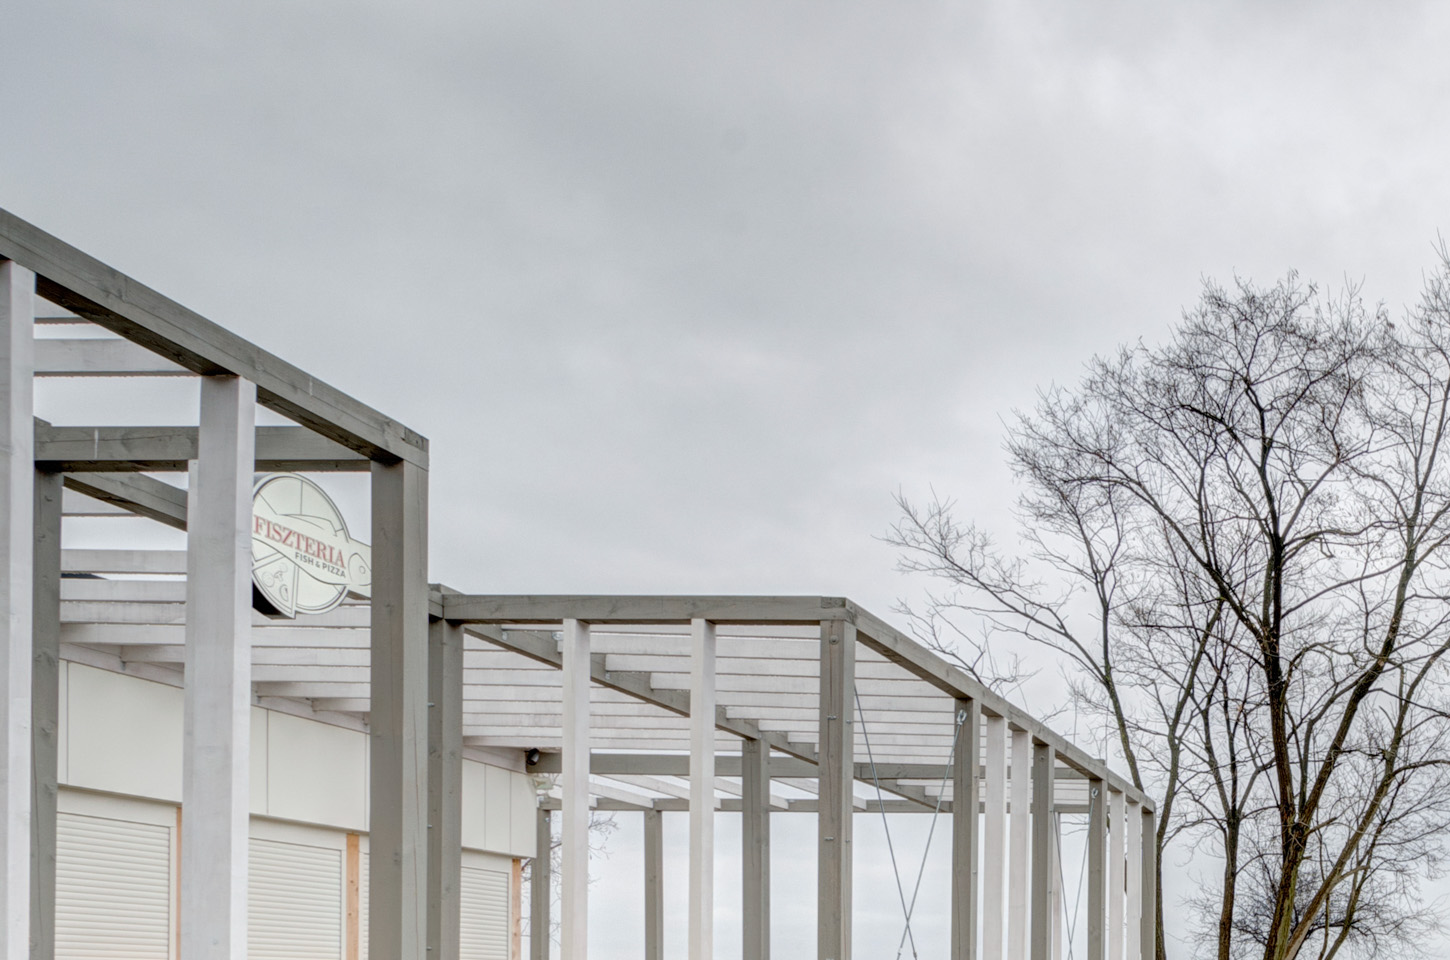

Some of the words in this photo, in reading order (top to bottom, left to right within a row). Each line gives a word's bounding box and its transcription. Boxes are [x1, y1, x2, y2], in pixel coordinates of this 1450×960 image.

[253, 514, 346, 569] FISZTERIA
[295, 552, 314, 568] FISH
[322, 563, 346, 578] PIZZA
